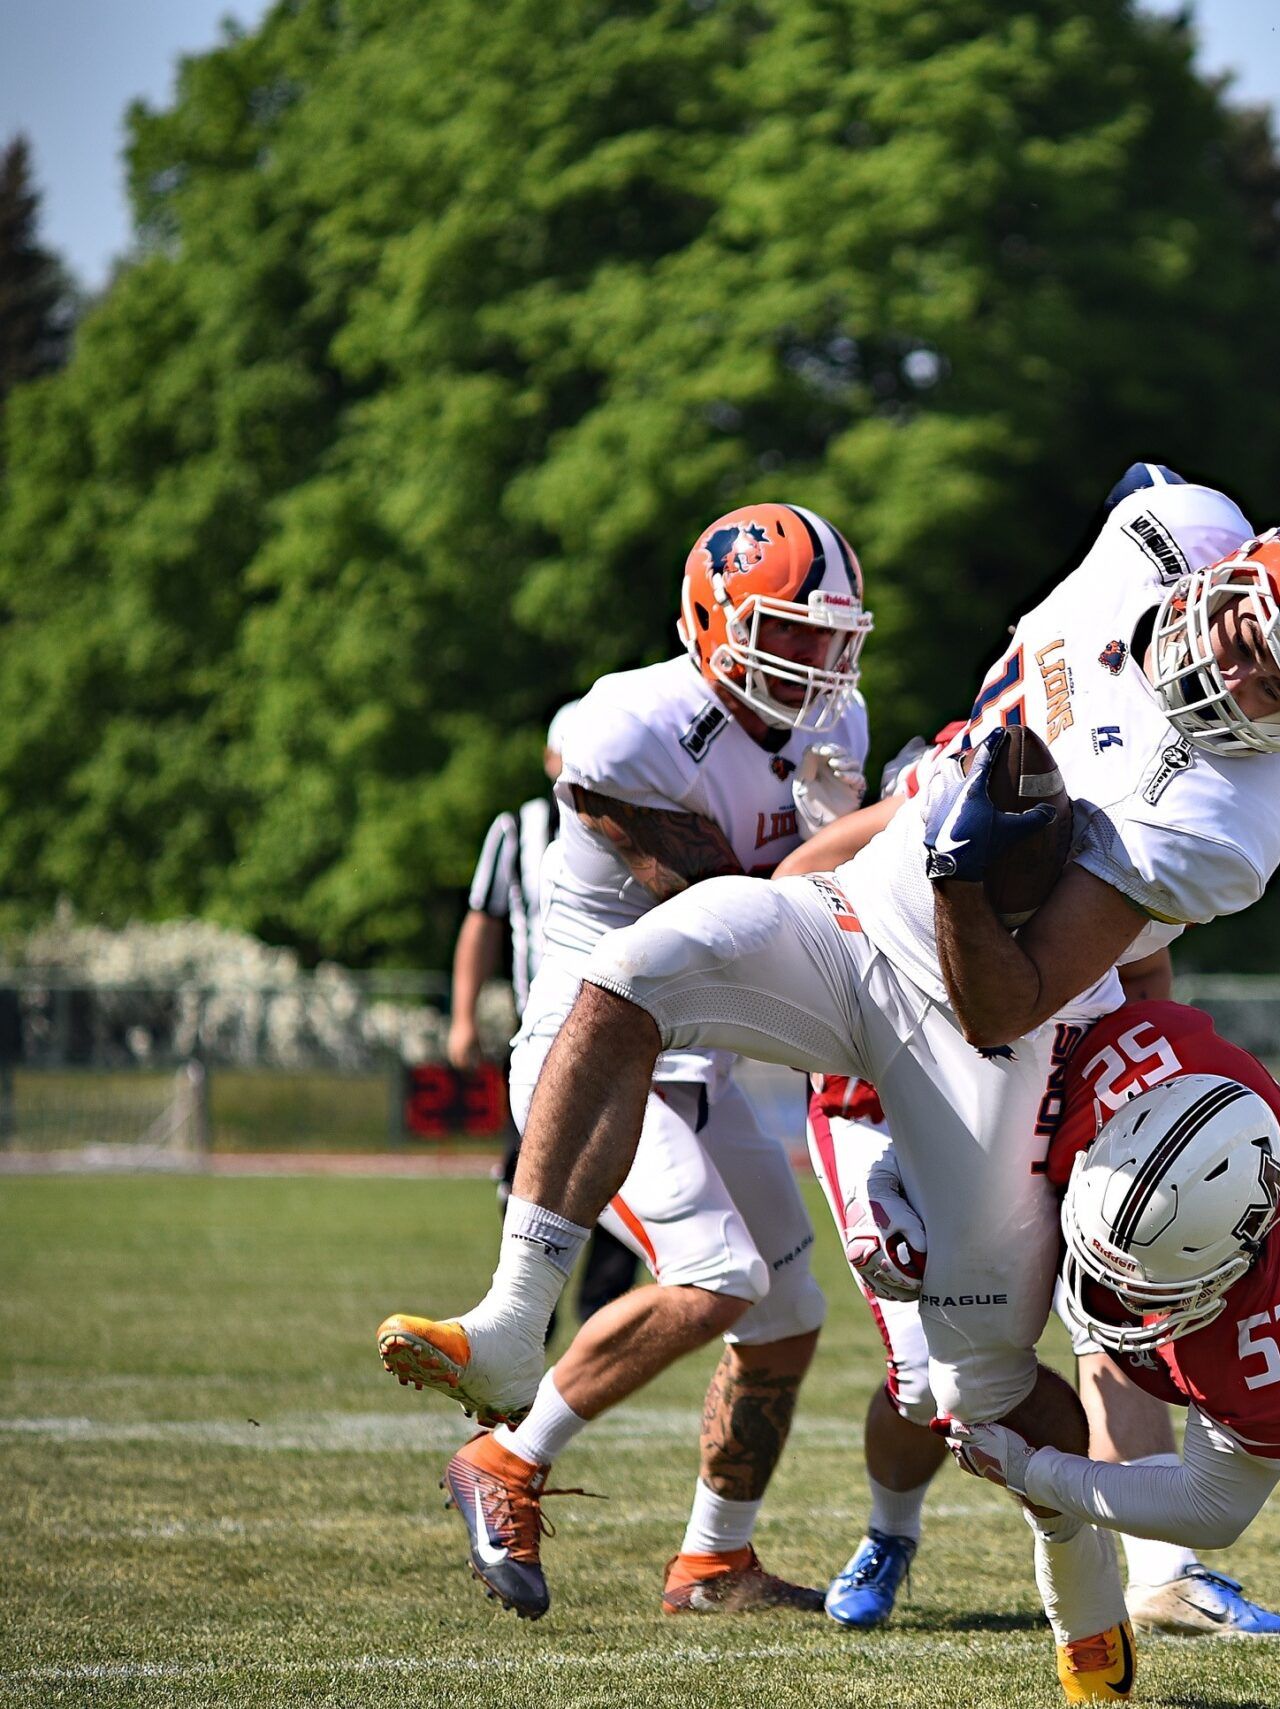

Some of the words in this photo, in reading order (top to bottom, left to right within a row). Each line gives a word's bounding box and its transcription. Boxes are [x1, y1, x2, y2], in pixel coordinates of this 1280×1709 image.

[1034, 639, 1075, 747] LIONS
[754, 810, 799, 851] LIO
[1092, 1238, 1137, 1273] Riddell
[921, 1293, 1008, 1307] PRAGUE
